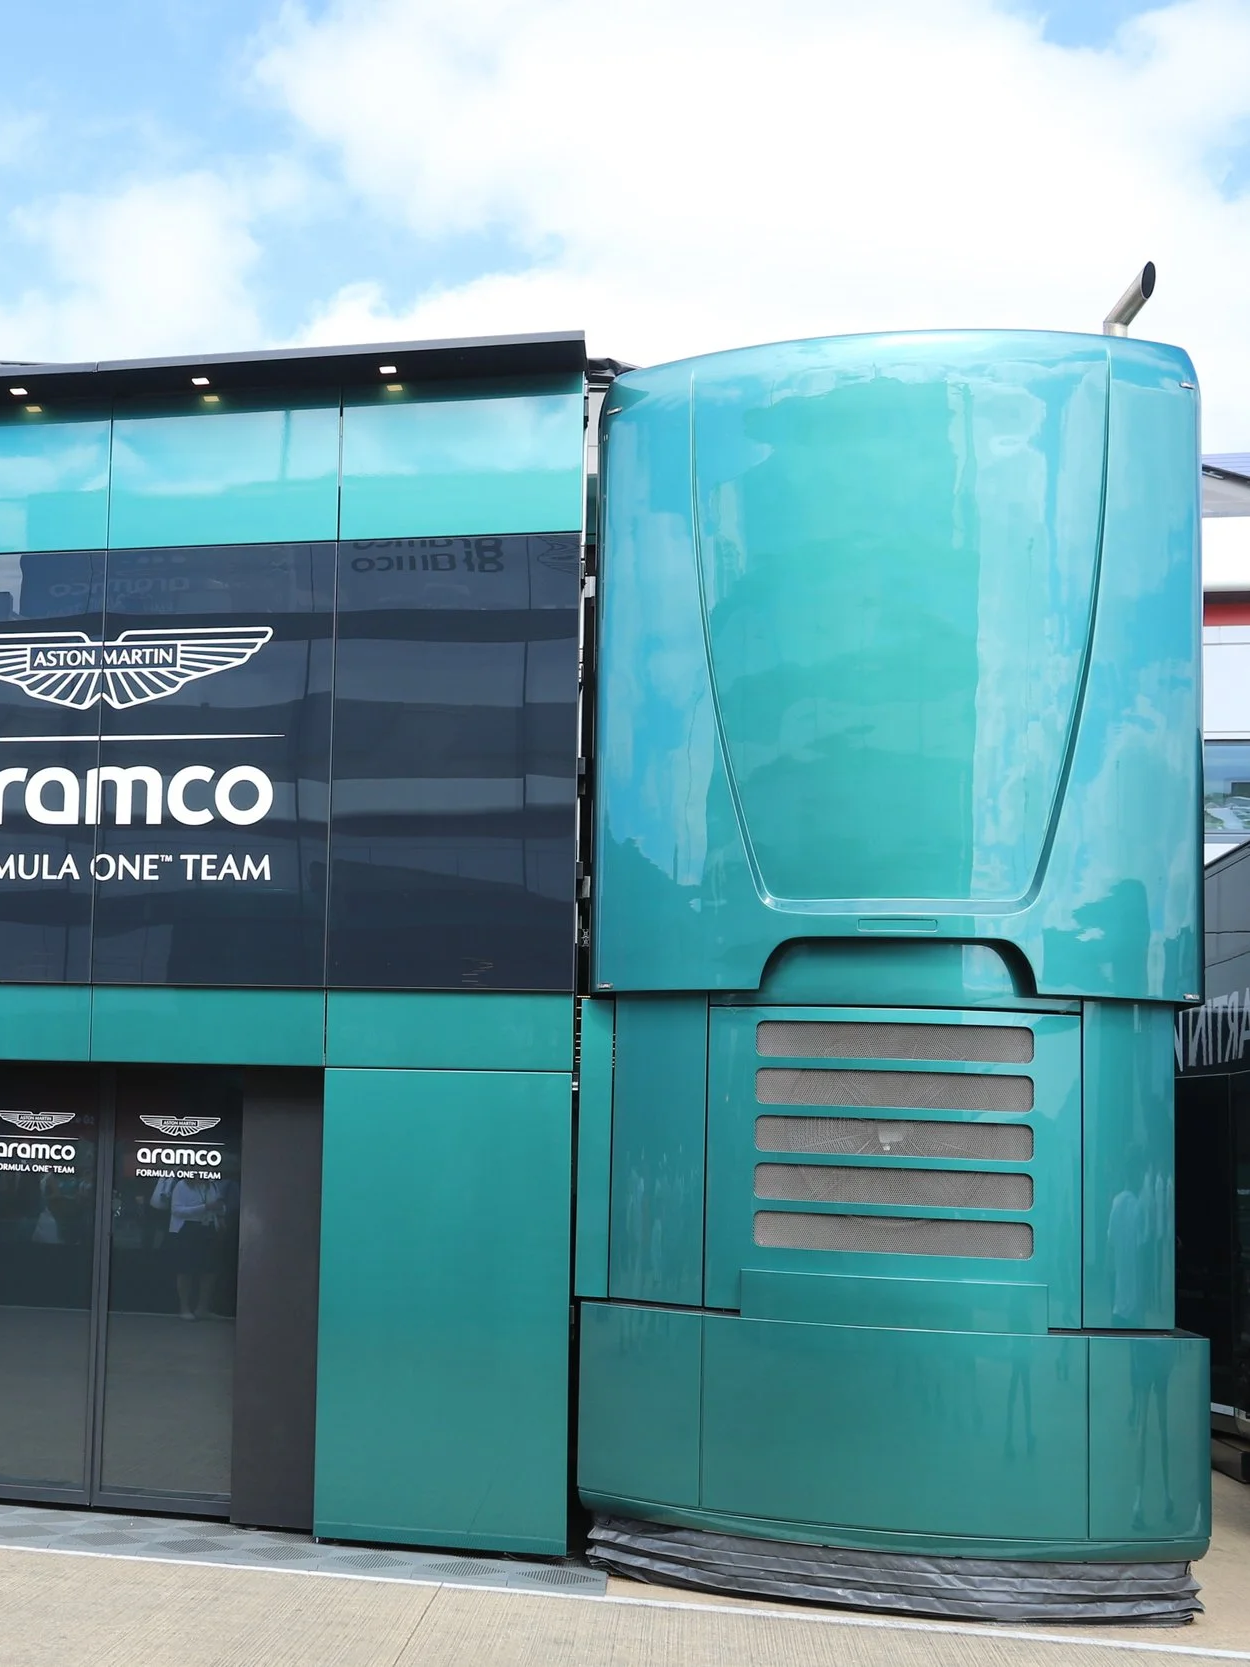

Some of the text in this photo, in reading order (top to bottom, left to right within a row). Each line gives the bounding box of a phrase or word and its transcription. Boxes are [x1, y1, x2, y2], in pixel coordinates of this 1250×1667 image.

[33, 647, 173, 667] ASTON MARTIN
[180, 854, 272, 881] TEAM
[136, 1147, 222, 1167] aramco
[53, 1165, 75, 1174] TEAM
[136, 1168, 175, 1178] FORMULA
[198, 1171, 221, 1180] TEAM
